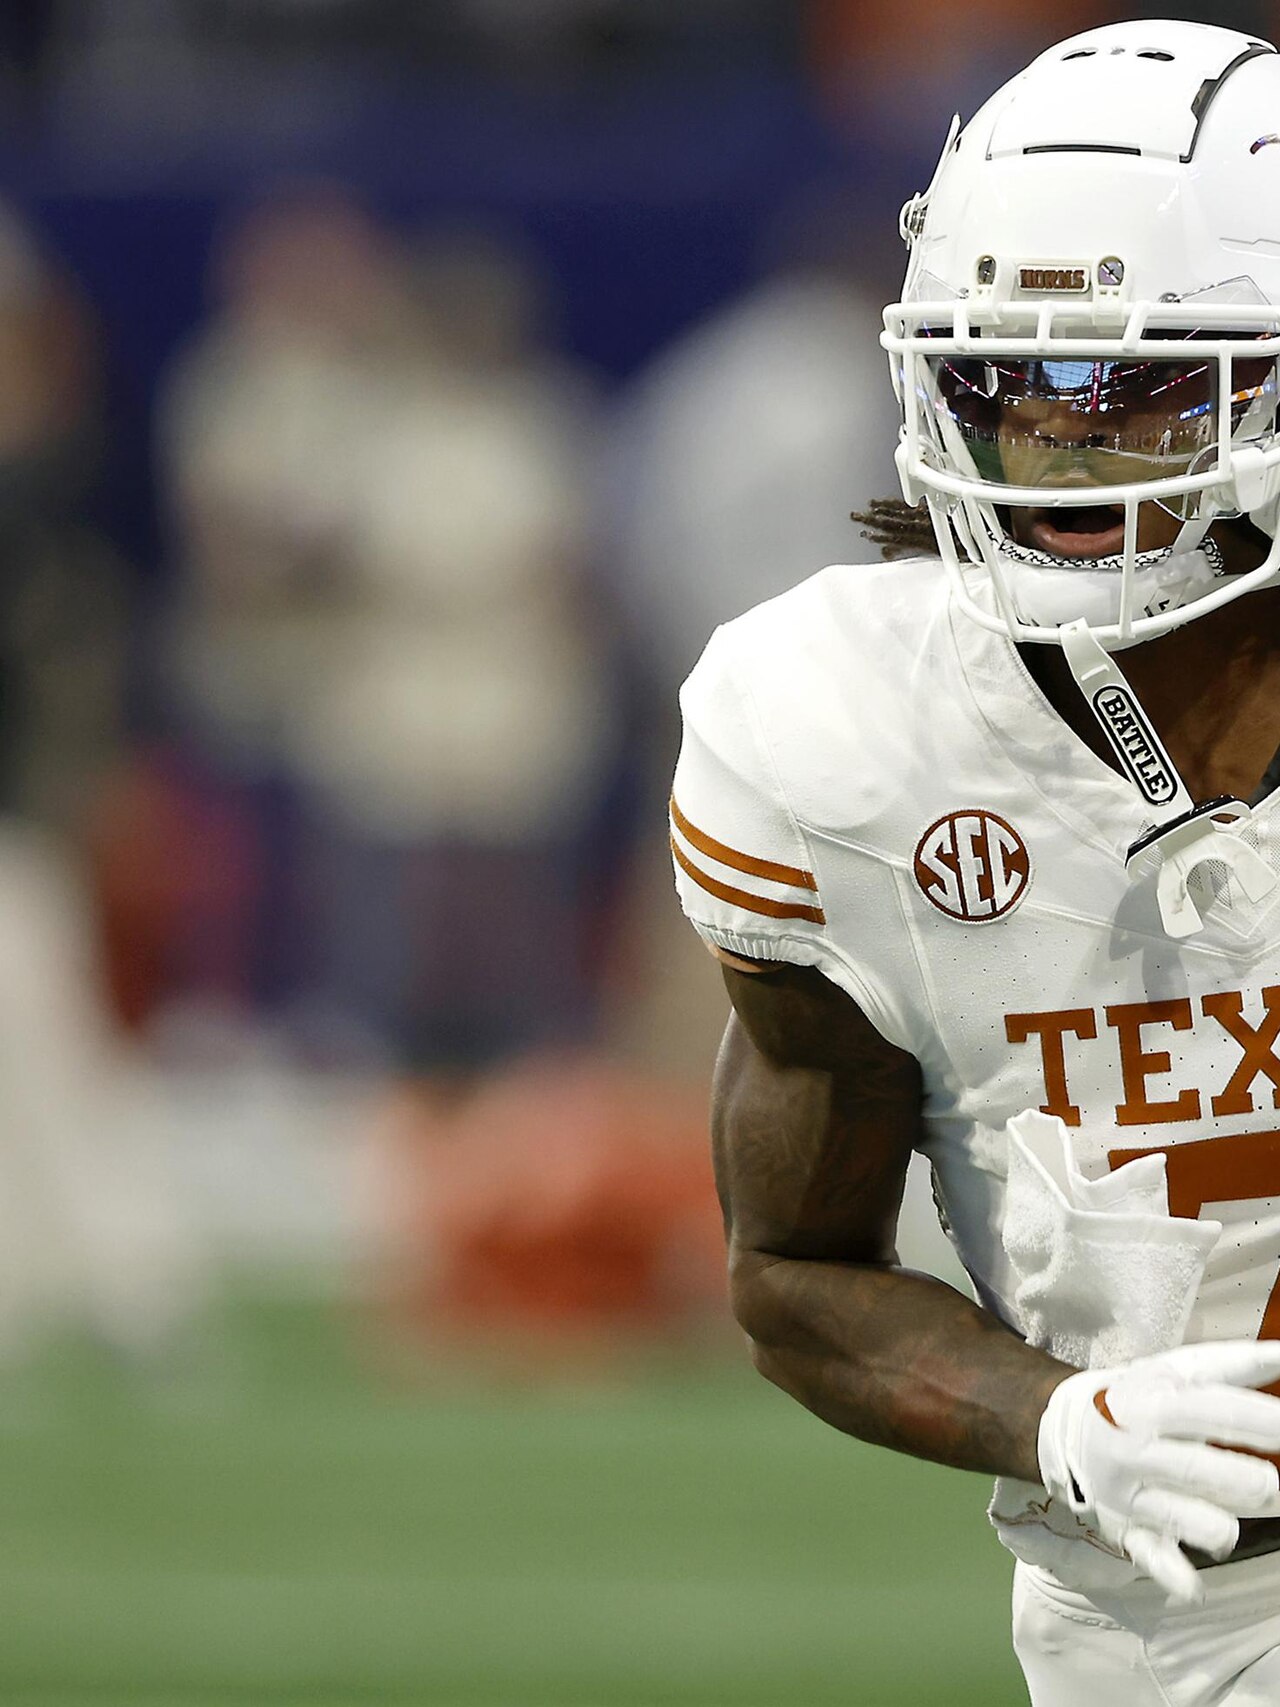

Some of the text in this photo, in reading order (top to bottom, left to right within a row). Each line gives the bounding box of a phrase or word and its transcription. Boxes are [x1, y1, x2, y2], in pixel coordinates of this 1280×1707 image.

[1020, 269, 1085, 289] HORNS
[1101, 694, 1170, 796] BATTLE
[919, 815, 1024, 917] SEC
